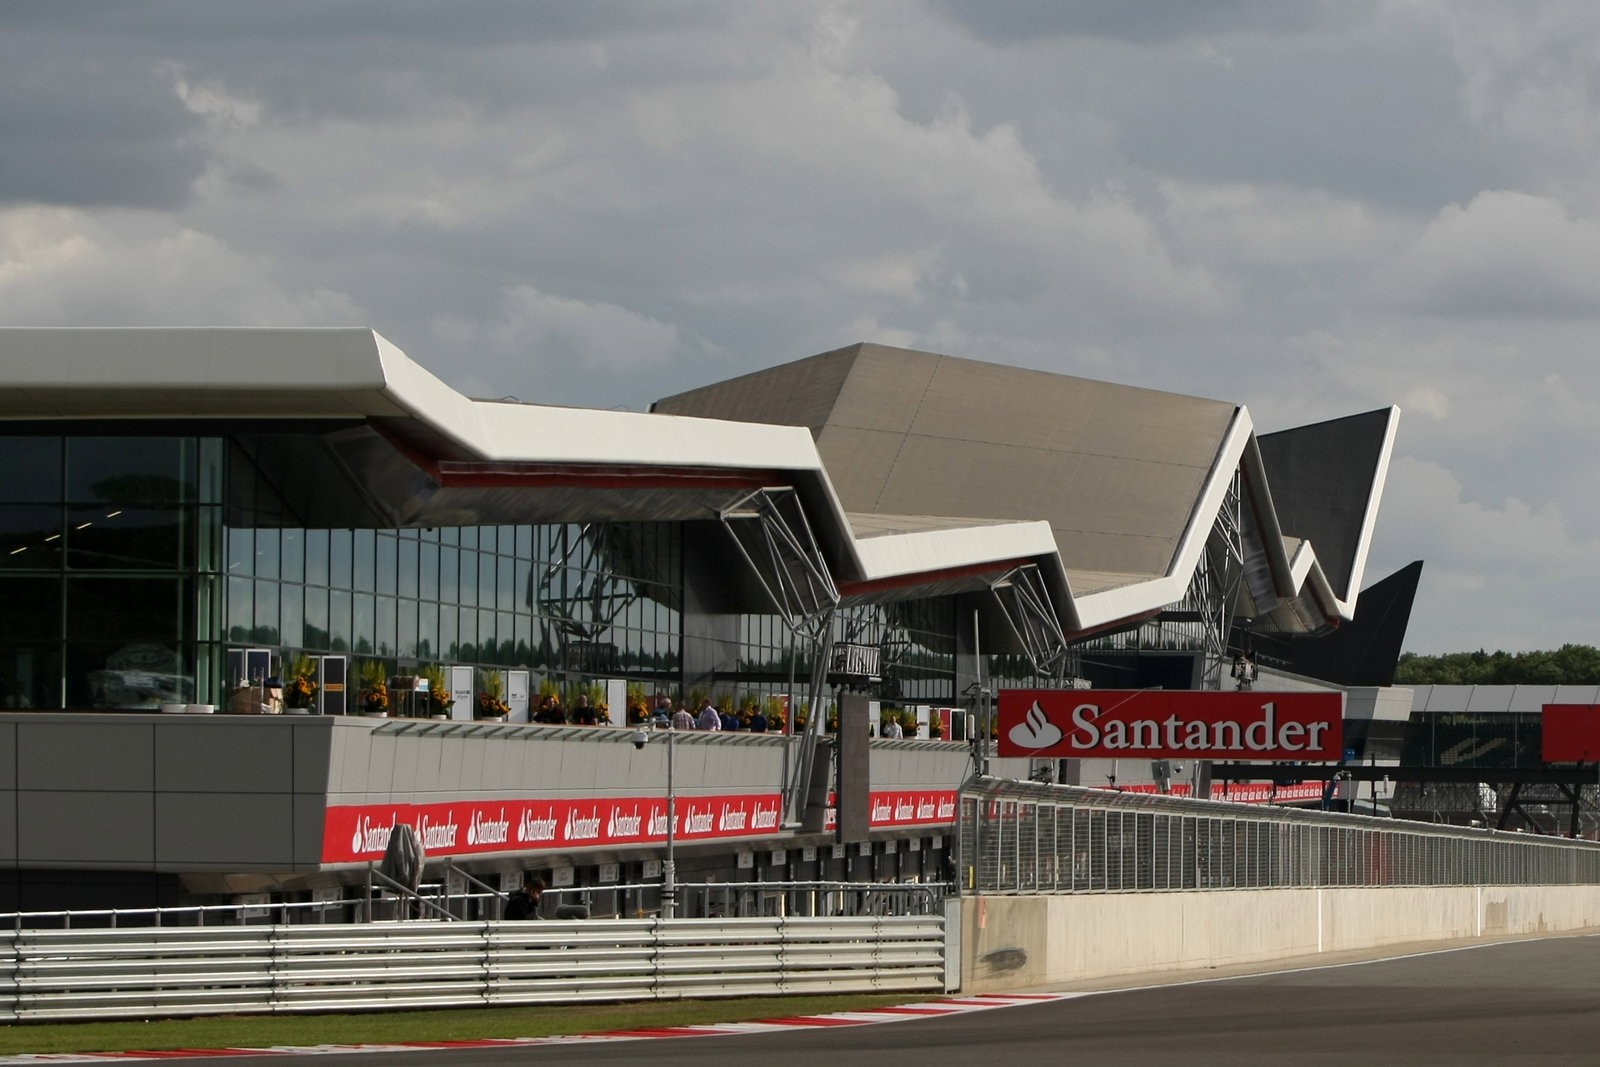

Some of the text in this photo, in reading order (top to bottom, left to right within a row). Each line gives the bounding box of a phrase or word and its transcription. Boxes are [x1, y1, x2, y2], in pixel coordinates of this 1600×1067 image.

[1070, 702, 1329, 751] Santander
[422, 809, 458, 850] Santander
[474, 807, 510, 845] Santander
[525, 805, 558, 841] Santander
